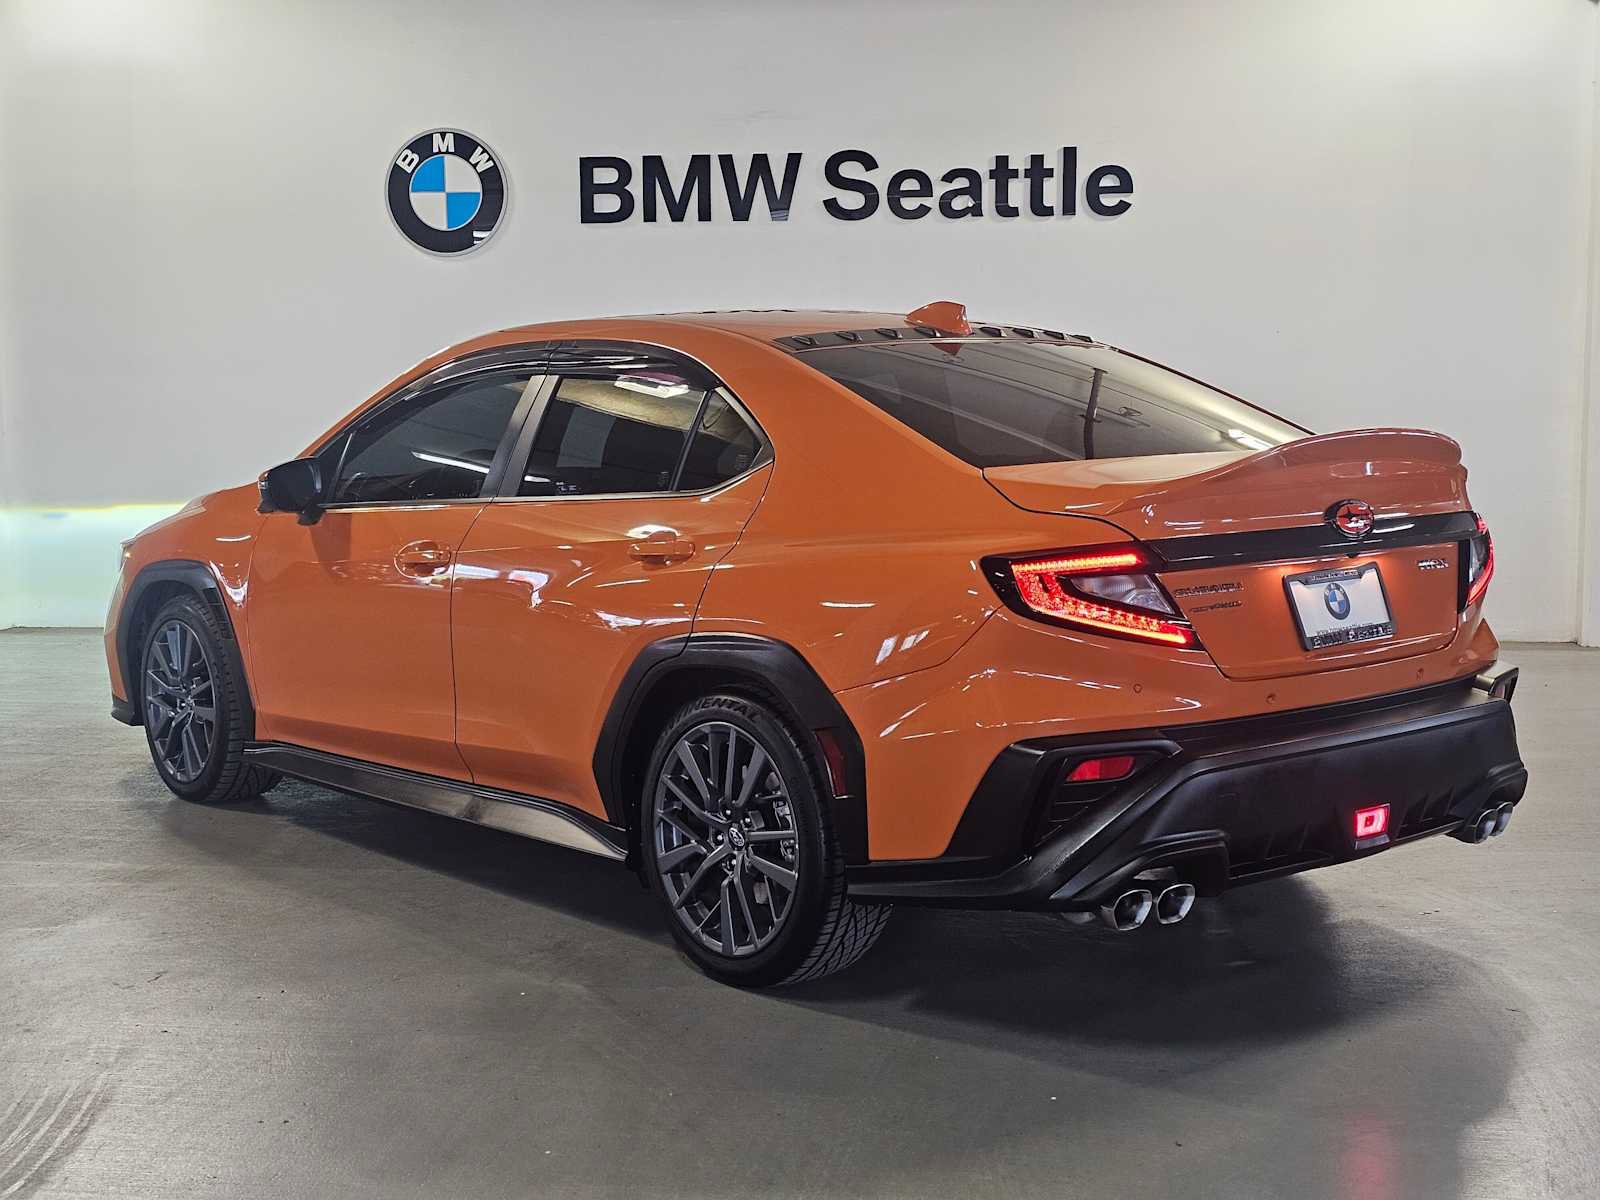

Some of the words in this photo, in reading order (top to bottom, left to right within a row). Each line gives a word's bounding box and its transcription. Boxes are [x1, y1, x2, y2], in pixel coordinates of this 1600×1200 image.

[395, 132, 495, 173] BMW
[579, 152, 803, 224] BMW
[822, 146, 1134, 221] Seattle
